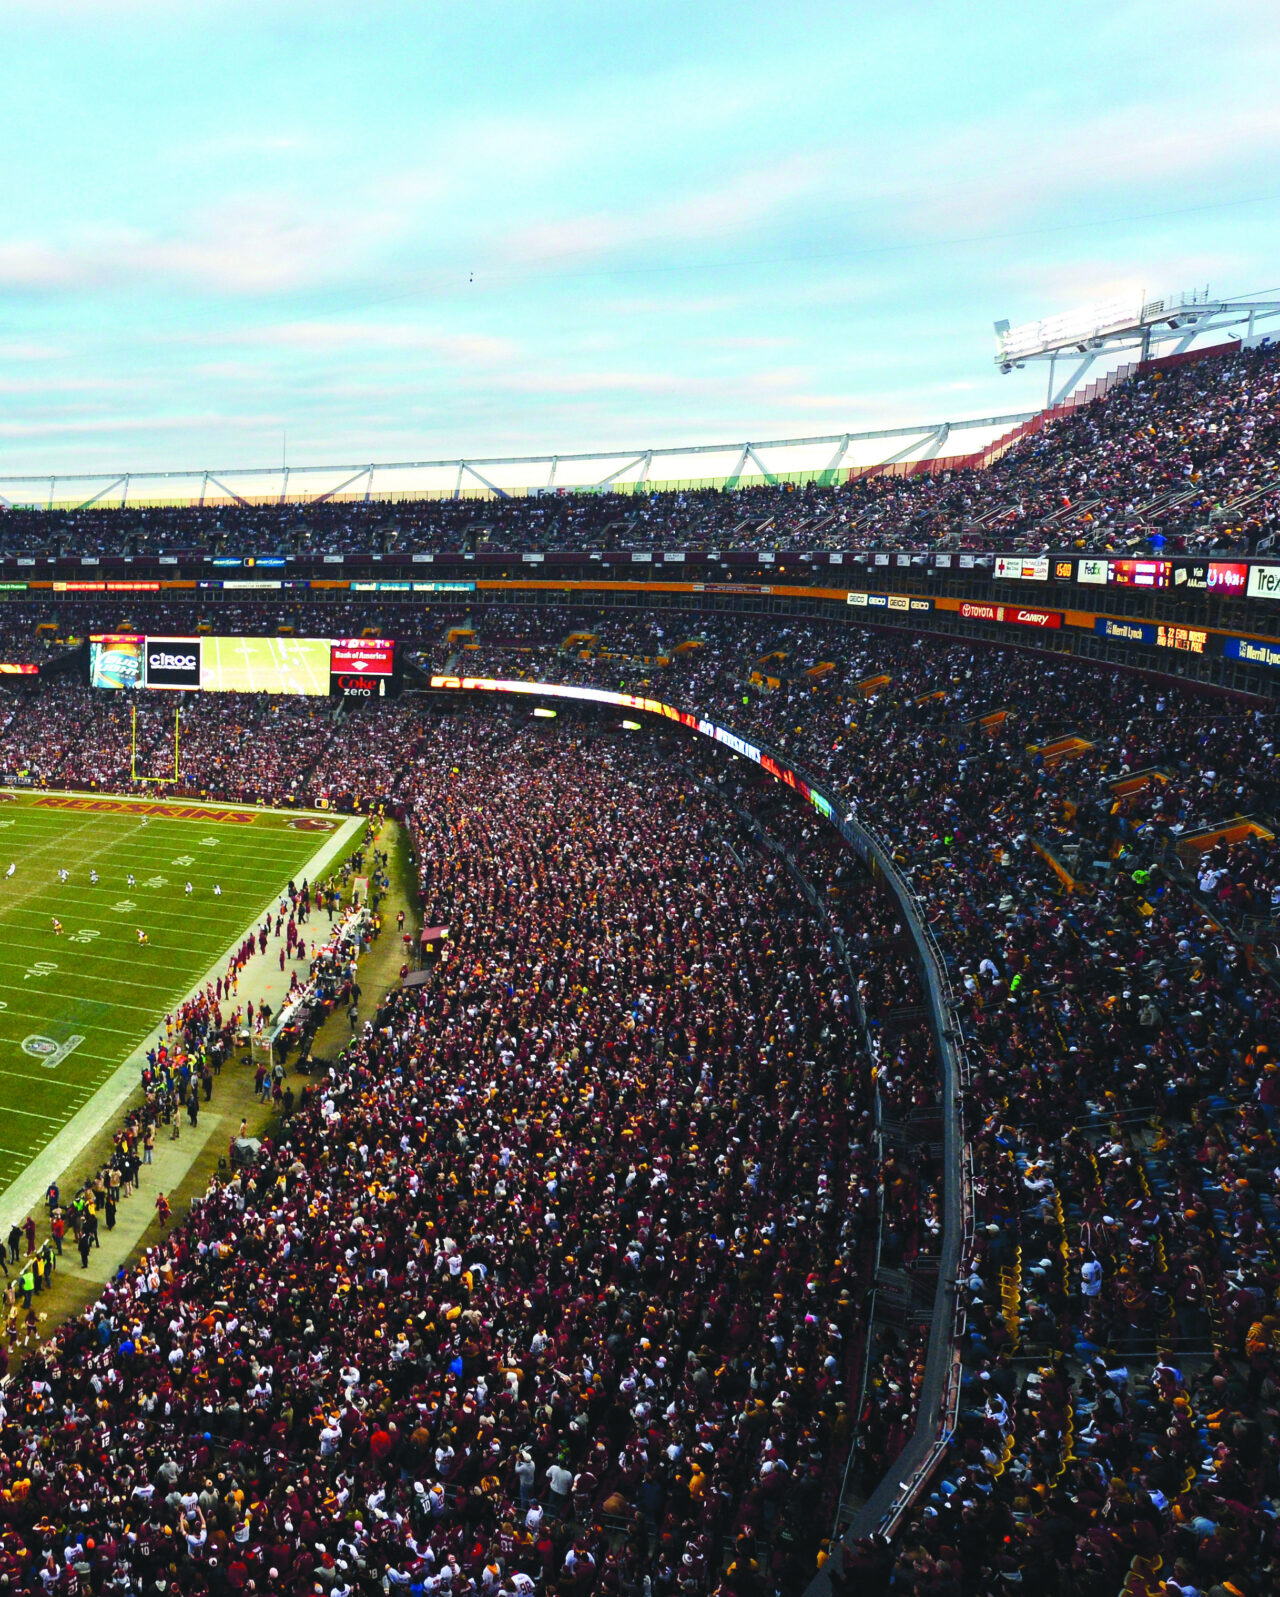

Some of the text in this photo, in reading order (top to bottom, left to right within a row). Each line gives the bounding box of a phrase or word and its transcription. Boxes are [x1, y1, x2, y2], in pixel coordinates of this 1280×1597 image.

[1085, 562, 1101, 575] FedEx
[849, 595, 865, 603] GEICO
[890, 599, 906, 608] GEICO
[970, 606, 994, 618] TOYOTA
[1017, 610, 1050, 626] CAMRY
[1112, 624, 1142, 640] Merrill Lynch
[359, 652, 387, 660] America
[1247, 645, 1266, 662] Merrill
[108, 656, 139, 668] BUD
[99, 663, 139, 676] LIGHT
[338, 675, 377, 690] Coke
[343, 688, 371, 697] zero
[699, 720, 762, 764] GO REDSKINS
[29, 798, 260, 824] REDSKINS
[200, 836, 220, 847] 10
[74, 929, 101, 943] 50
[26, 962, 58, 977] 40
[101, 1437, 110, 1448] 12
[422, 1500, 431, 1511] 10
[140, 1546, 150, 1556] 10
[520, 1581, 531, 1594] 98
